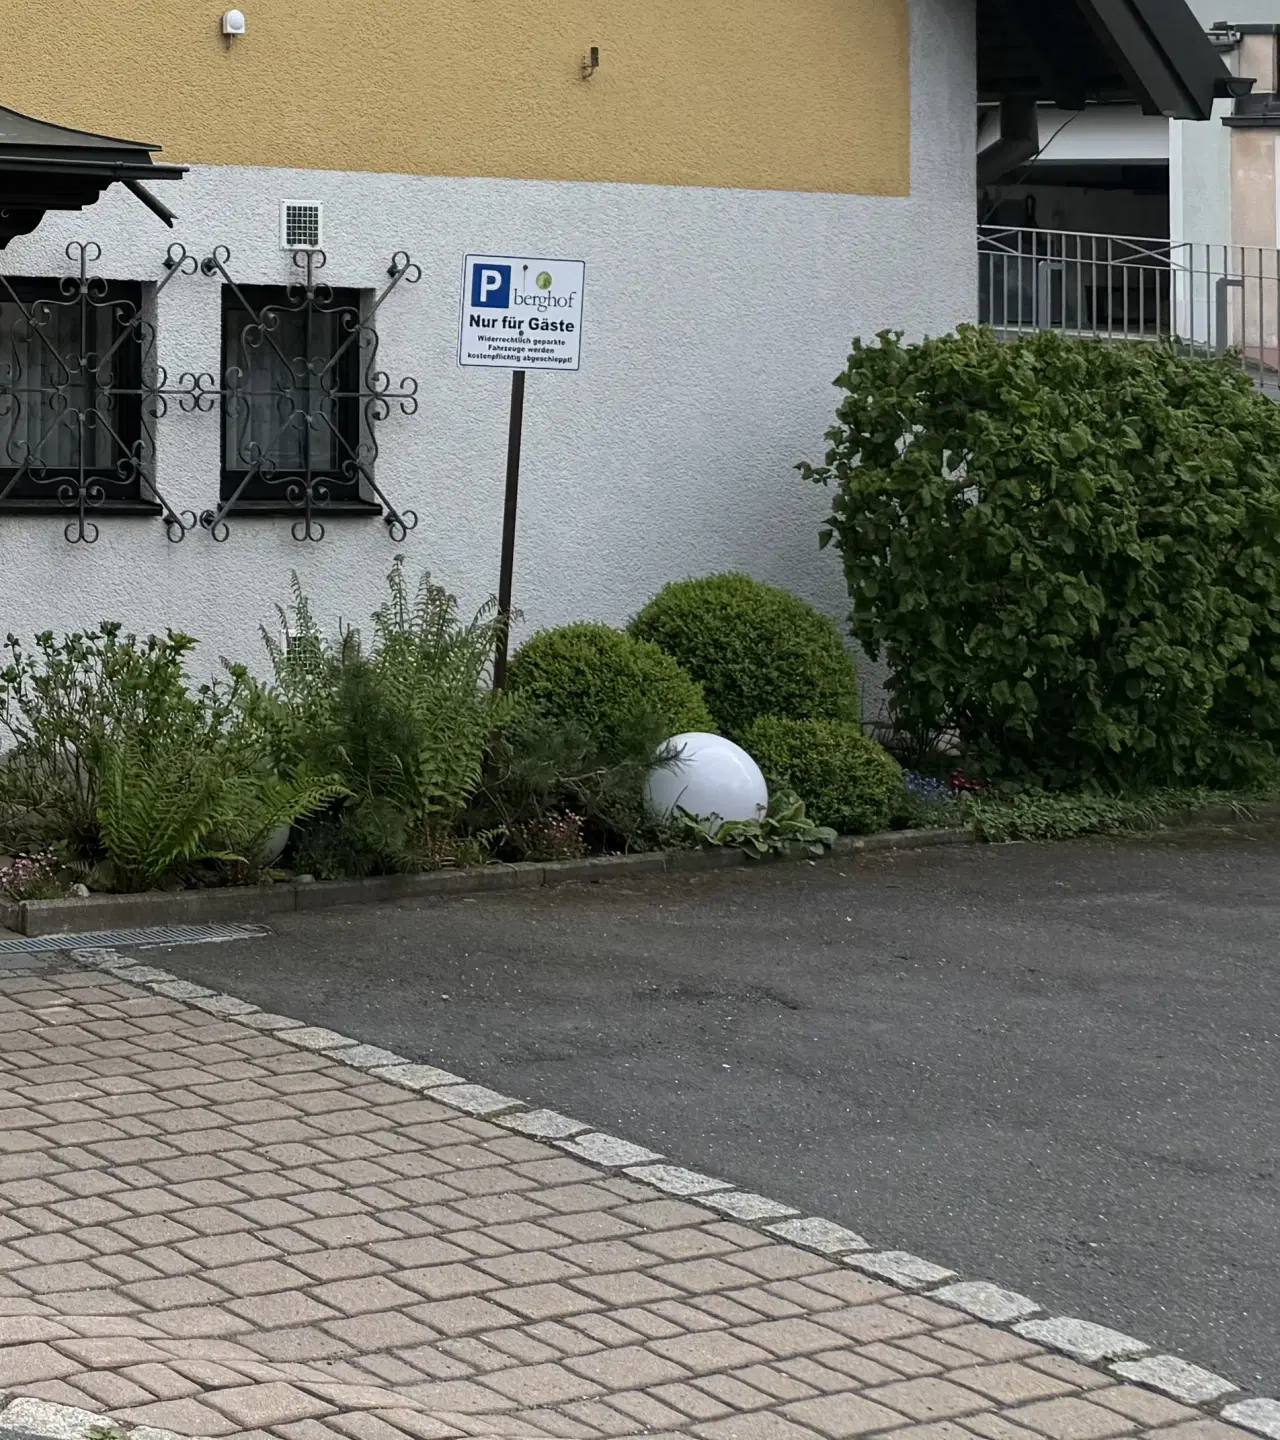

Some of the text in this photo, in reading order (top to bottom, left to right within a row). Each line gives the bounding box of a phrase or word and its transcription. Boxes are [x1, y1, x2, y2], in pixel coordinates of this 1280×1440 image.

[480, 269, 502, 302] P
[514, 288, 577, 313] berghof
[469, 314, 575, 332] Nur für Gäste
[477, 335, 566, 346] Widerrechtlich geparkte
[488, 344, 525, 353] Fahrzeuge
[467, 352, 573, 364] kostenpflichtig abgeschleppt!
